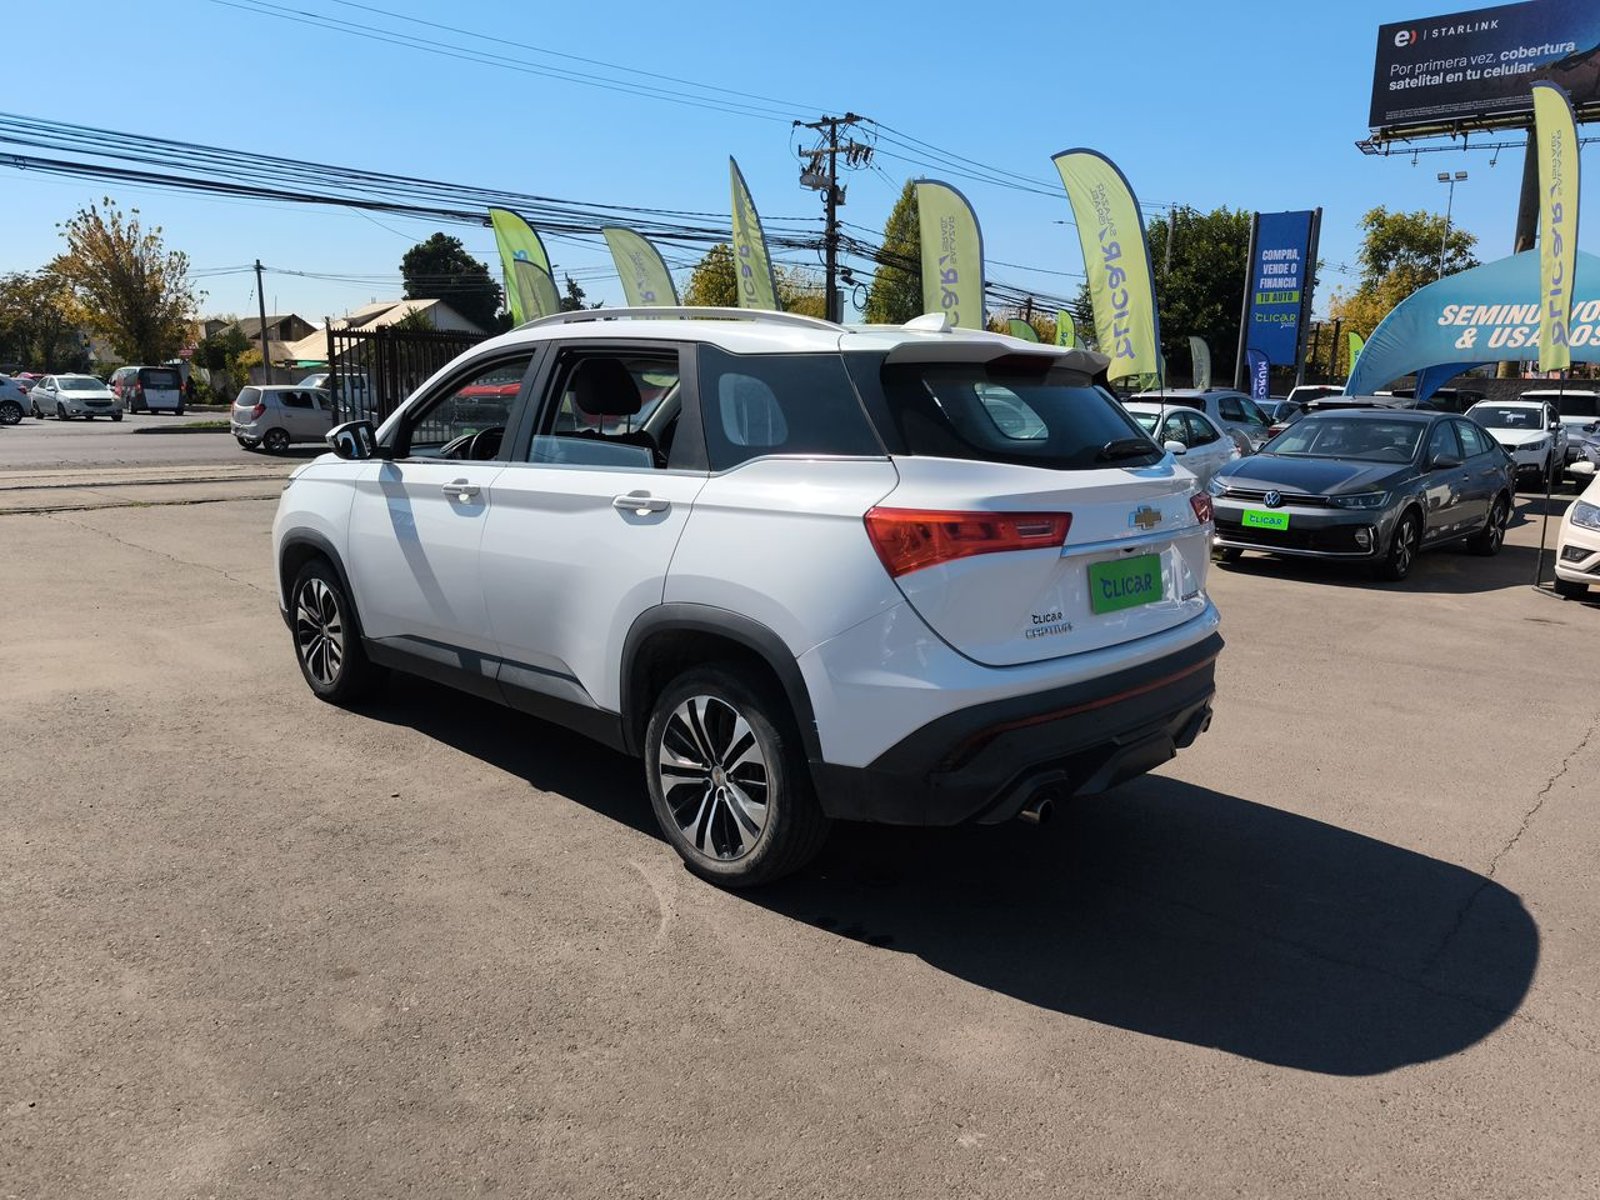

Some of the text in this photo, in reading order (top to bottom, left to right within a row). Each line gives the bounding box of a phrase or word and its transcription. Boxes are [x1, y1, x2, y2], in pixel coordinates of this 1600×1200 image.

[1432, 19, 1499, 38] STARLINK
[1390, 63, 1413, 77] Por
[1415, 57, 1467, 75] primera
[1500, 40, 1576, 61] cobertura
[1389, 61, 1537, 91] satelital en tu celular.
[1263, 263, 1297, 275] VENDE O
[1259, 277, 1297, 289] FINANCIA
[1260, 291, 1294, 303] TU AUTO
[1455, 327, 1478, 349] &
